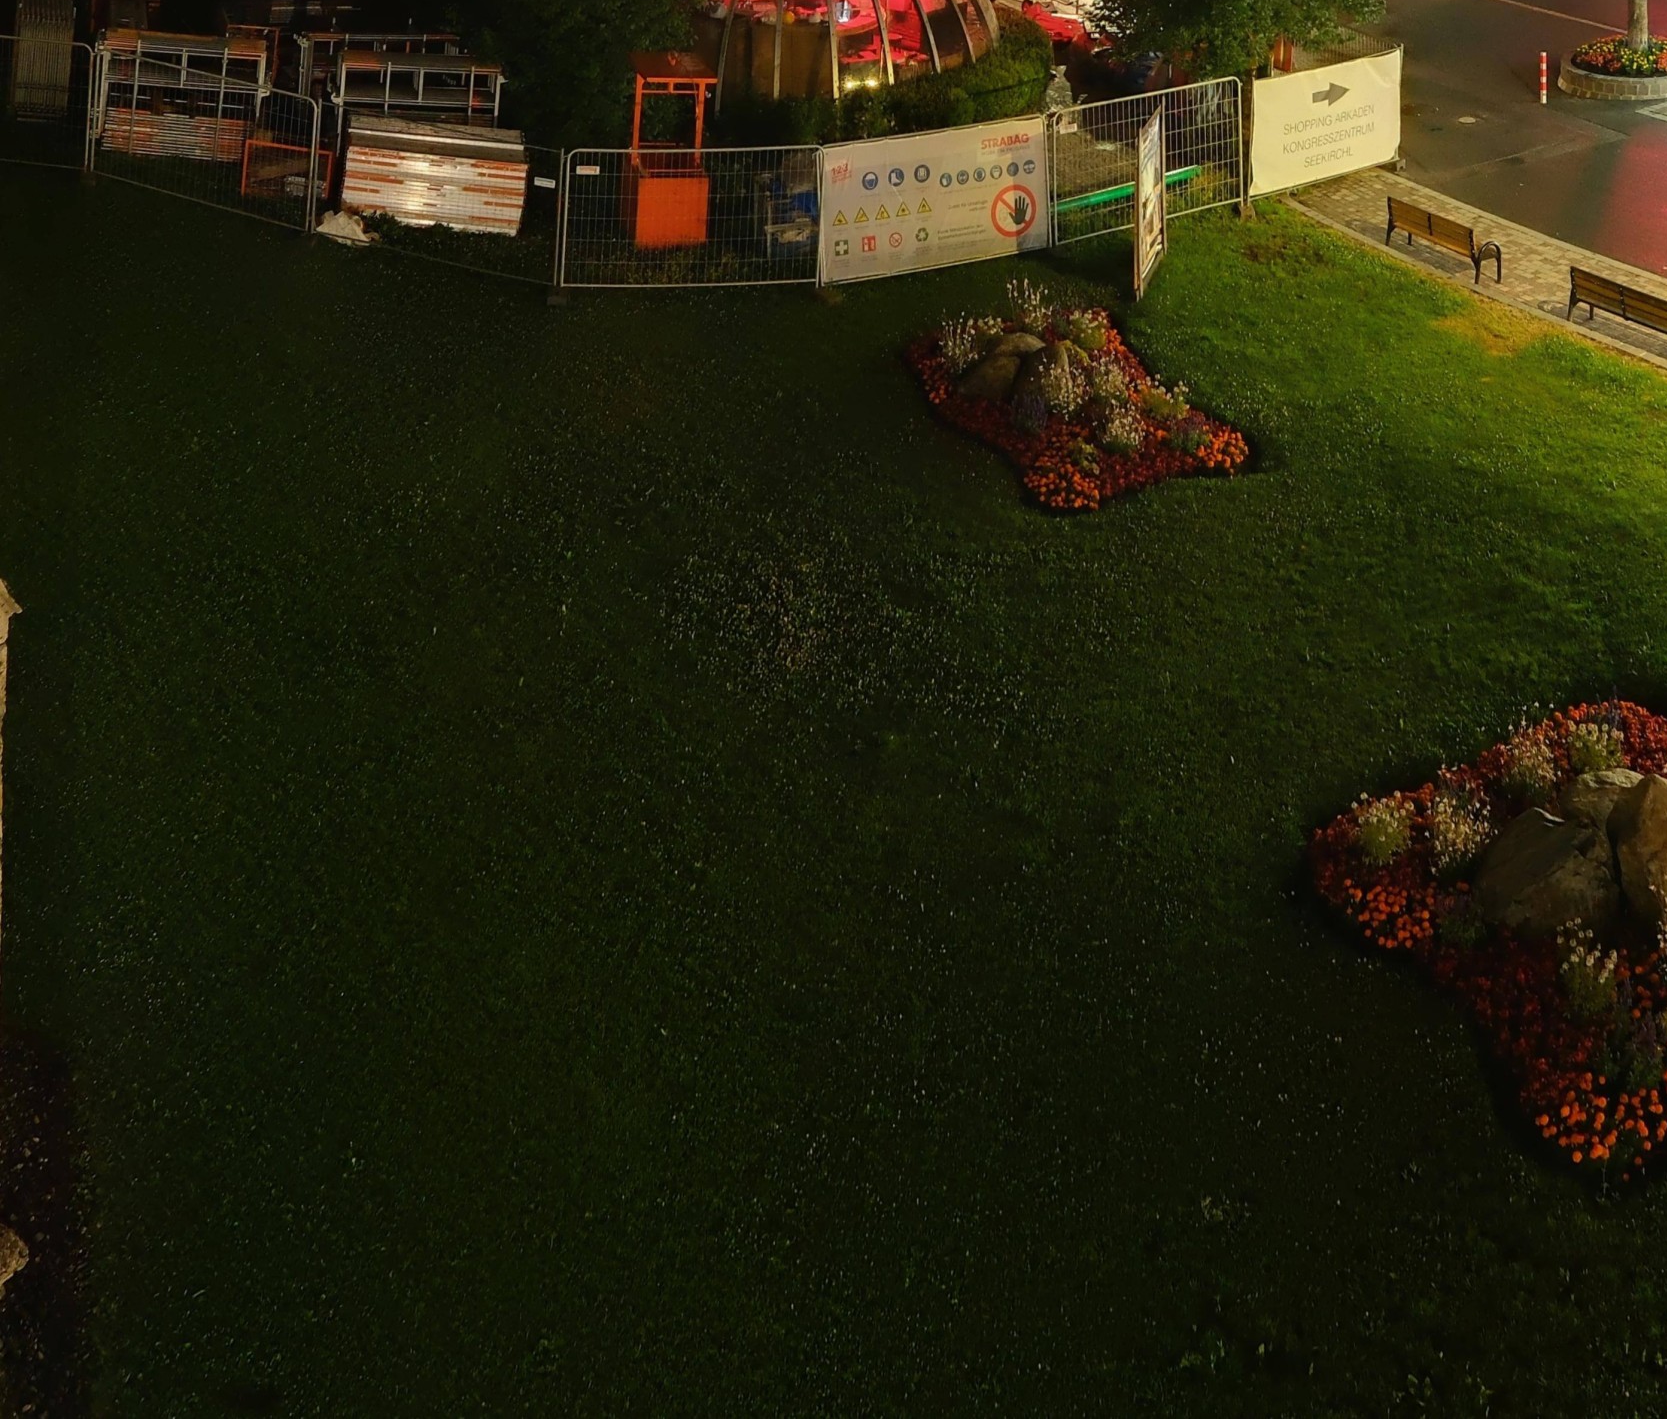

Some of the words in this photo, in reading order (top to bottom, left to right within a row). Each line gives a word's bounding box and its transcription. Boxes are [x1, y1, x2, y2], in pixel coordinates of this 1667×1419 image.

[1283, 115, 1332, 136] SHOPPING
[1335, 104, 1375, 123] ARKADEN
[981, 133, 1030, 150] STRABAG
[1283, 122, 1375, 154] KONGRESSZENTRUM
[1304, 147, 1353, 168] SEEKIRCHL
